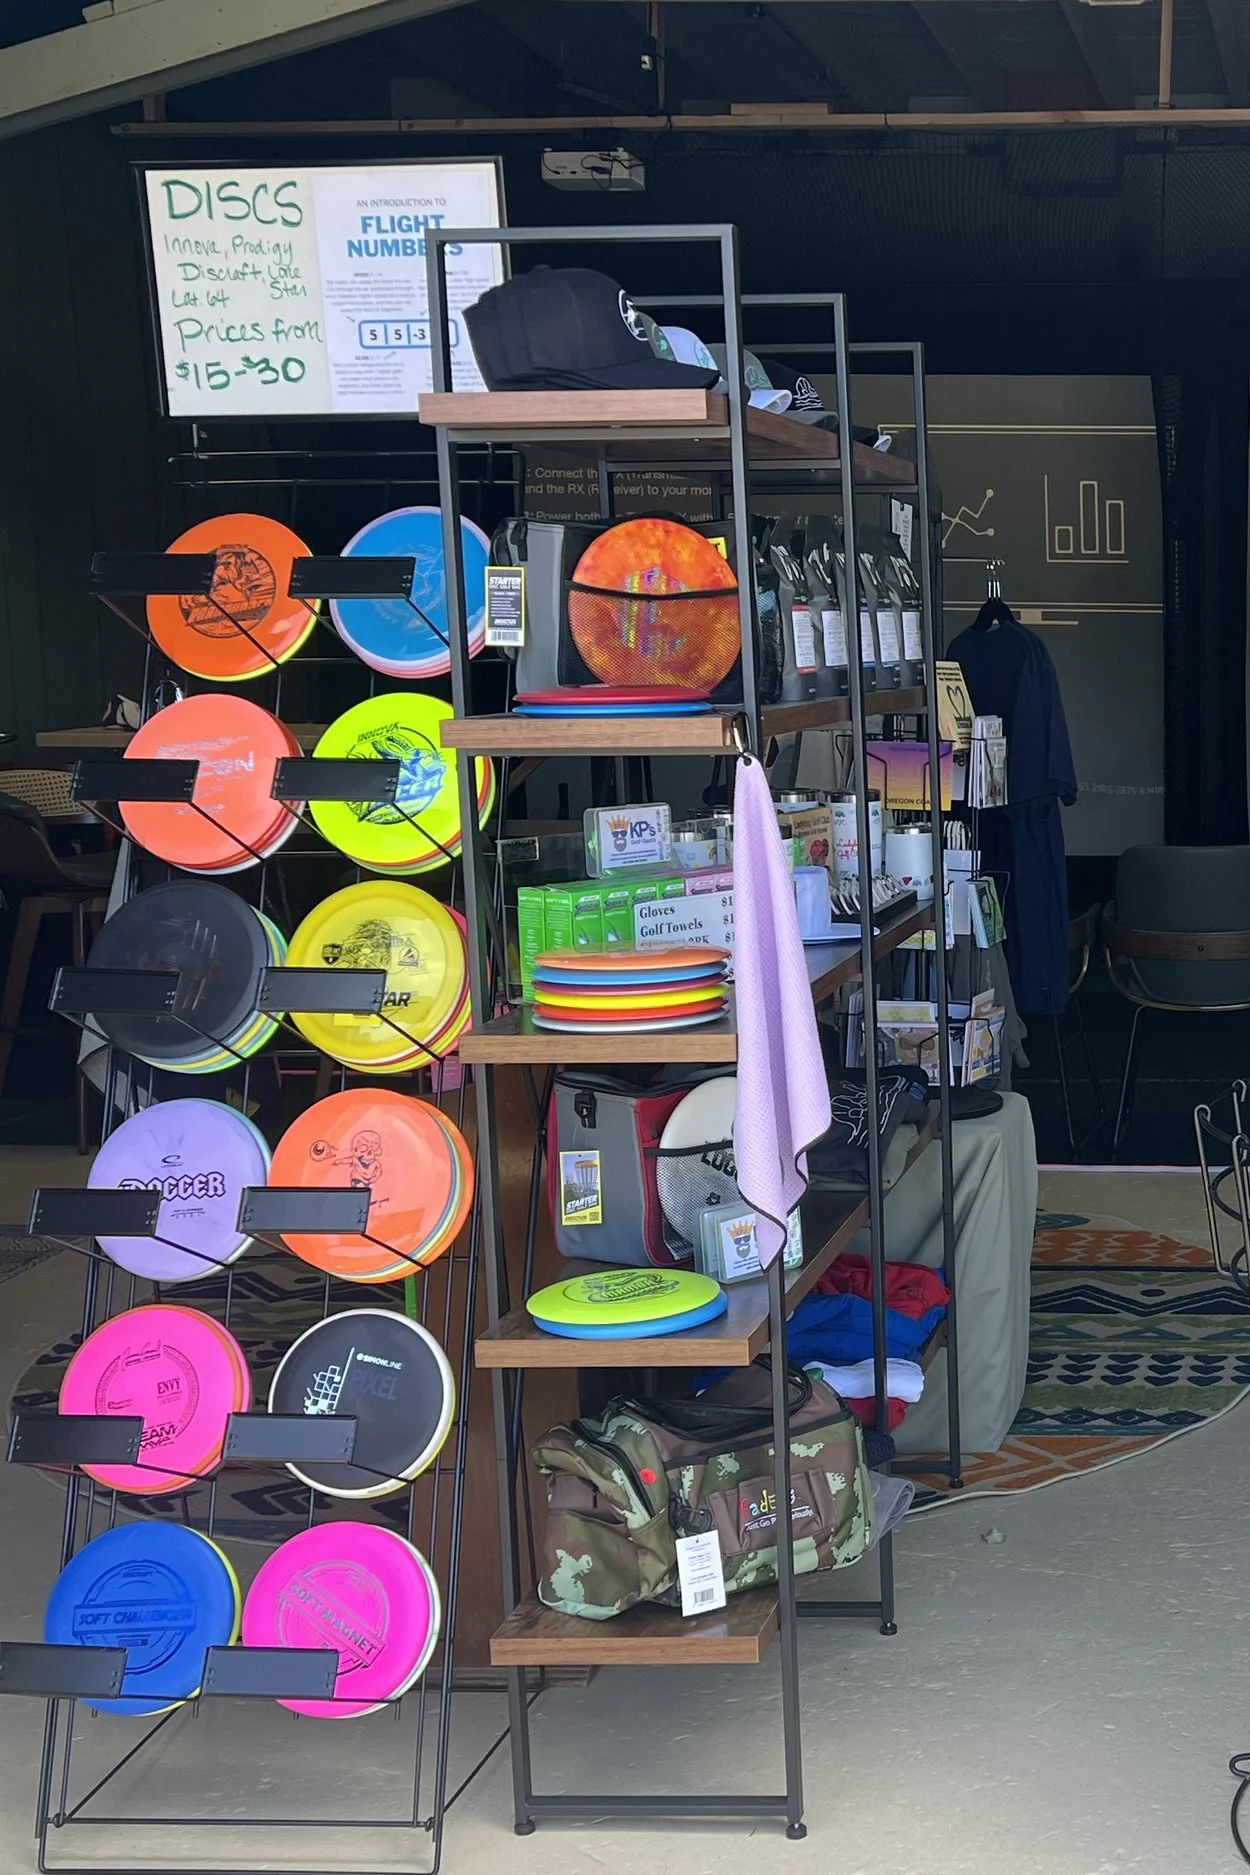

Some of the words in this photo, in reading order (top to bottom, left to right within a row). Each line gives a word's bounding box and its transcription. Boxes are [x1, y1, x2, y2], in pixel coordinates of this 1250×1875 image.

[161, 179, 303, 228] DISCS
[356, 199, 368, 208] AN
[370, 198, 433, 208] INTRODUCTION
[434, 197, 447, 206] TO
[360, 214, 445, 235] FLIGHT
[232, 235, 293, 266] Prodigy
[347, 238, 463, 258] NUMBES
[174, 318, 265, 353] Prices
[272, 318, 324, 344] from
[369, 329, 378, 341] 5
[394, 329, 402, 340] 5
[535, 467, 584, 480] Connect
[587, 467, 598, 479] th
[547, 484, 565, 494] the
[567, 484, 583, 494] RX
[647, 485, 659, 495] to
[661, 486, 686, 498] your
[489, 576, 522, 585] STARTER
[639, 905, 675, 919] Gloves
[640, 922, 664, 937] Golf
[667, 918, 703, 933] Towels
[157, 1377, 181, 1395] ENVY
[350, 1366, 399, 1401] PIXEL
[760, 1520, 771, 1528] Go
[78, 1612, 112, 1626] SOFT
[114, 1608, 192, 1624] CHALLENGER
[289, 1581, 323, 1610] SOFT
[321, 1608, 378, 1655] MAGNET
